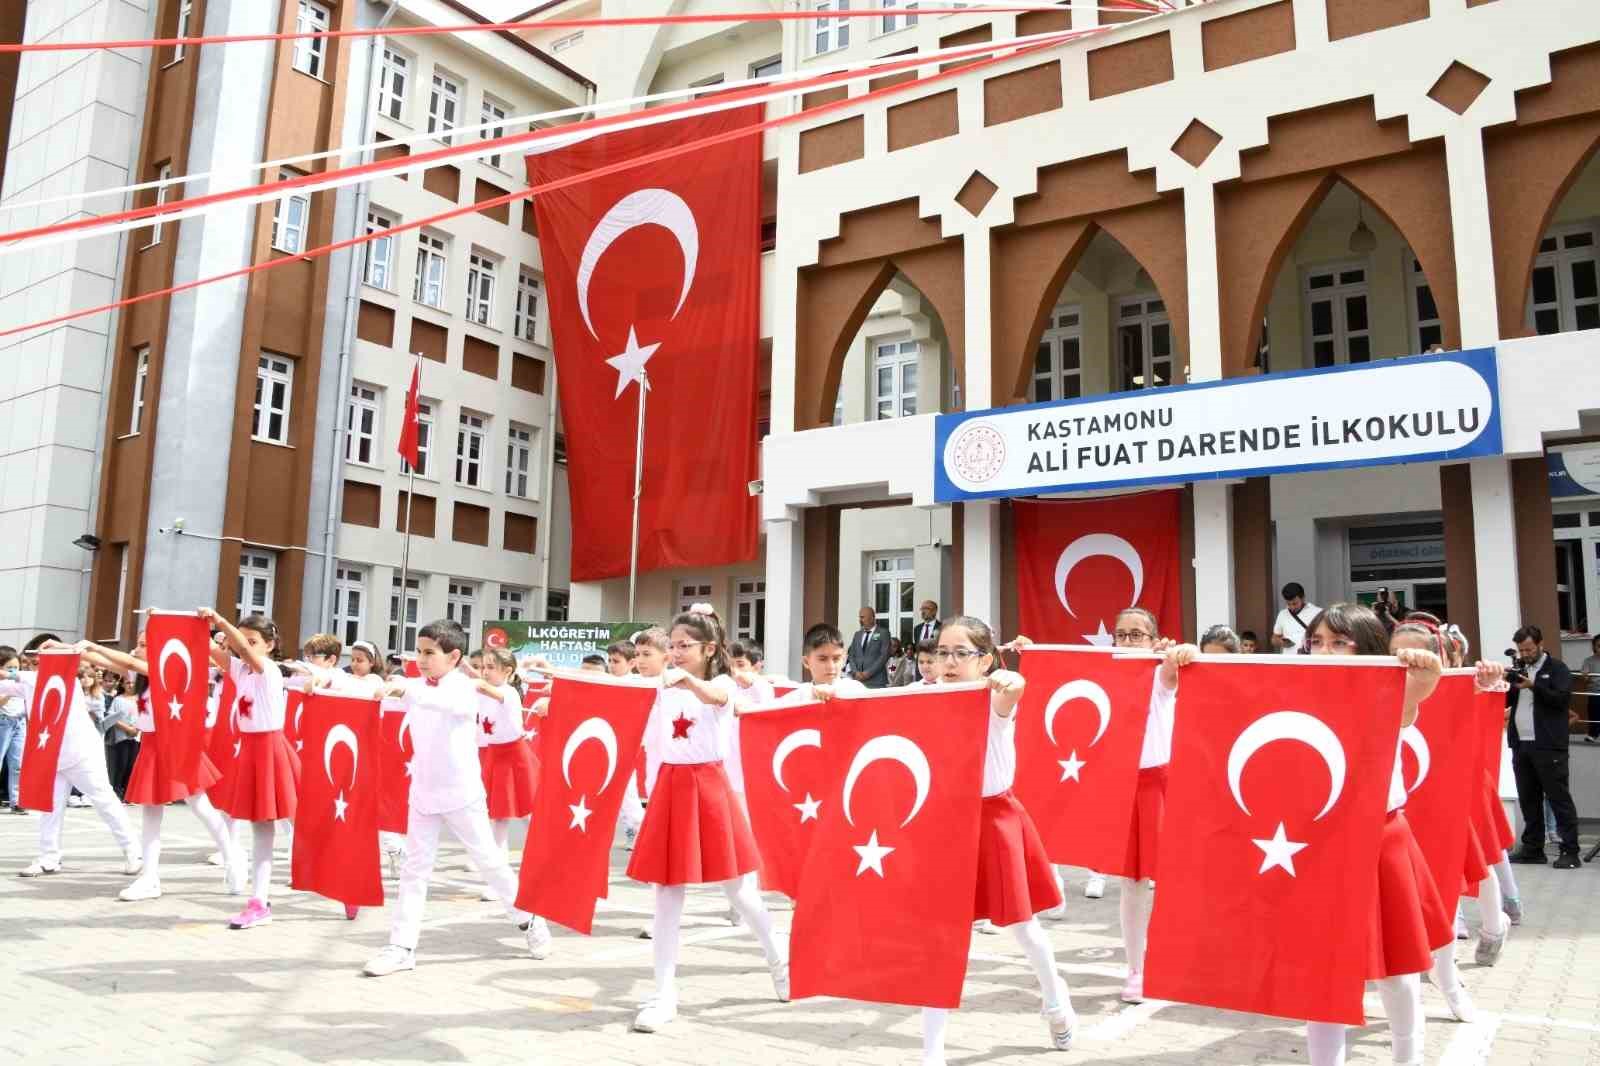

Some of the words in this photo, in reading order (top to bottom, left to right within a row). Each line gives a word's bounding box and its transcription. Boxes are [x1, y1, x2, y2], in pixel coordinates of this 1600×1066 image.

[1028, 407, 1173, 442] KASTAMONU
[1027, 443, 1069, 474] ALİ
[1077, 440, 1148, 469] FUAT
[1158, 427, 1301, 462] DARENDE
[1311, 407, 1480, 446] İLKOKULU
[528, 626, 610, 640] İLKÖĞRETİM
[540, 640, 597, 651] HAFTASI
